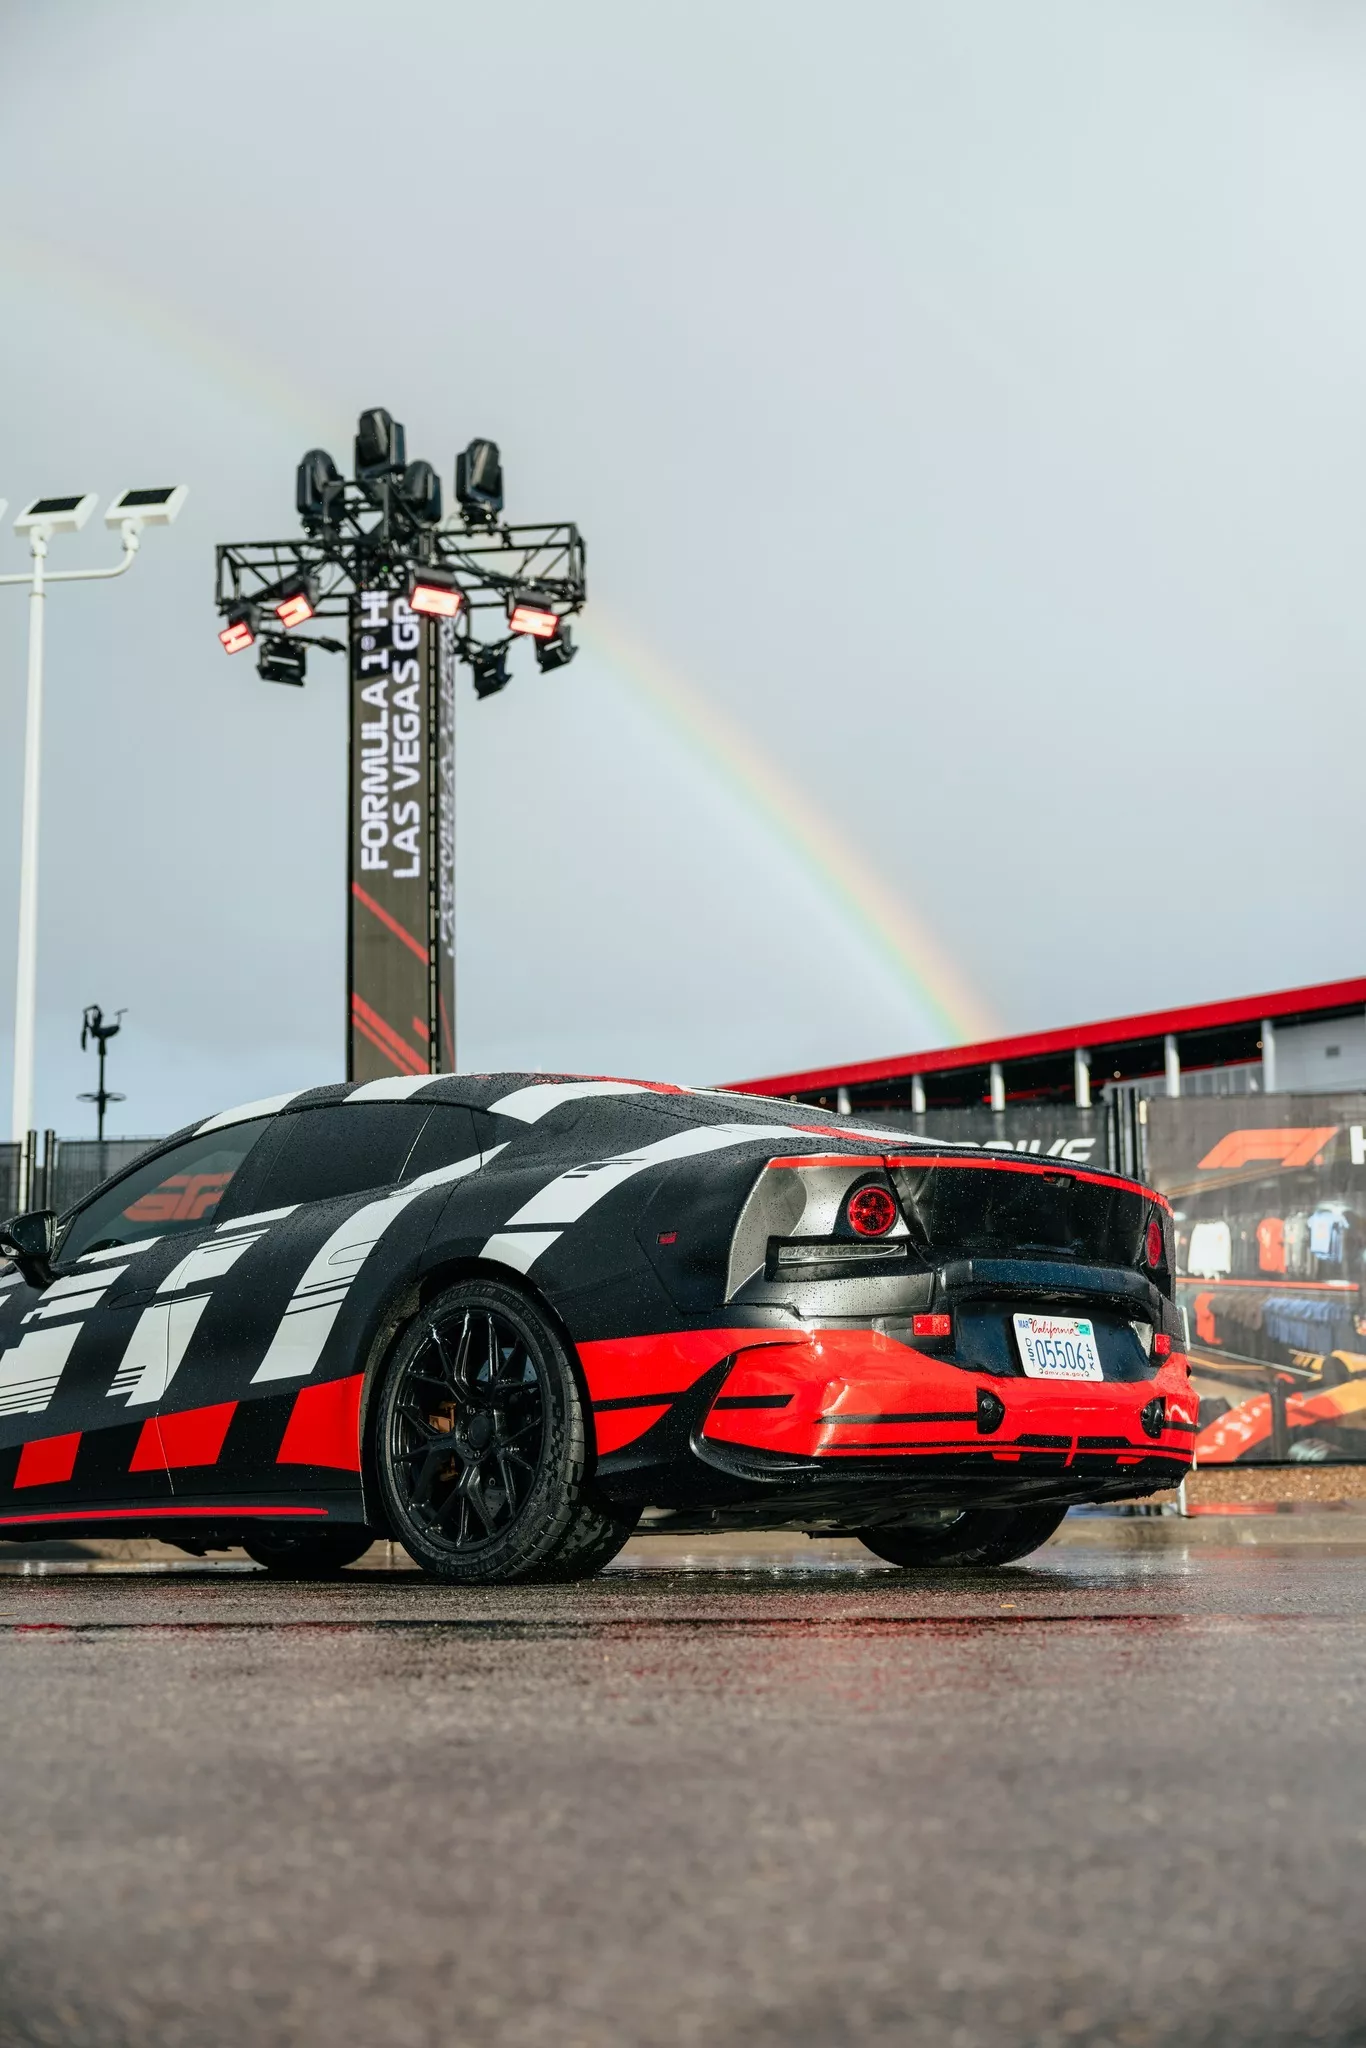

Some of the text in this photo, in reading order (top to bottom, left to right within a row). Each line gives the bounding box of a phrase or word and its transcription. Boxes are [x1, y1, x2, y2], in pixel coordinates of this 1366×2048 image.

[392, 659, 420, 791] VEGAS
[361, 679, 389, 870] FORMULA
[392, 800, 420, 878] LAS
[1031, 1319, 1079, 1338] California
[1035, 1339, 1086, 1371] 05506
